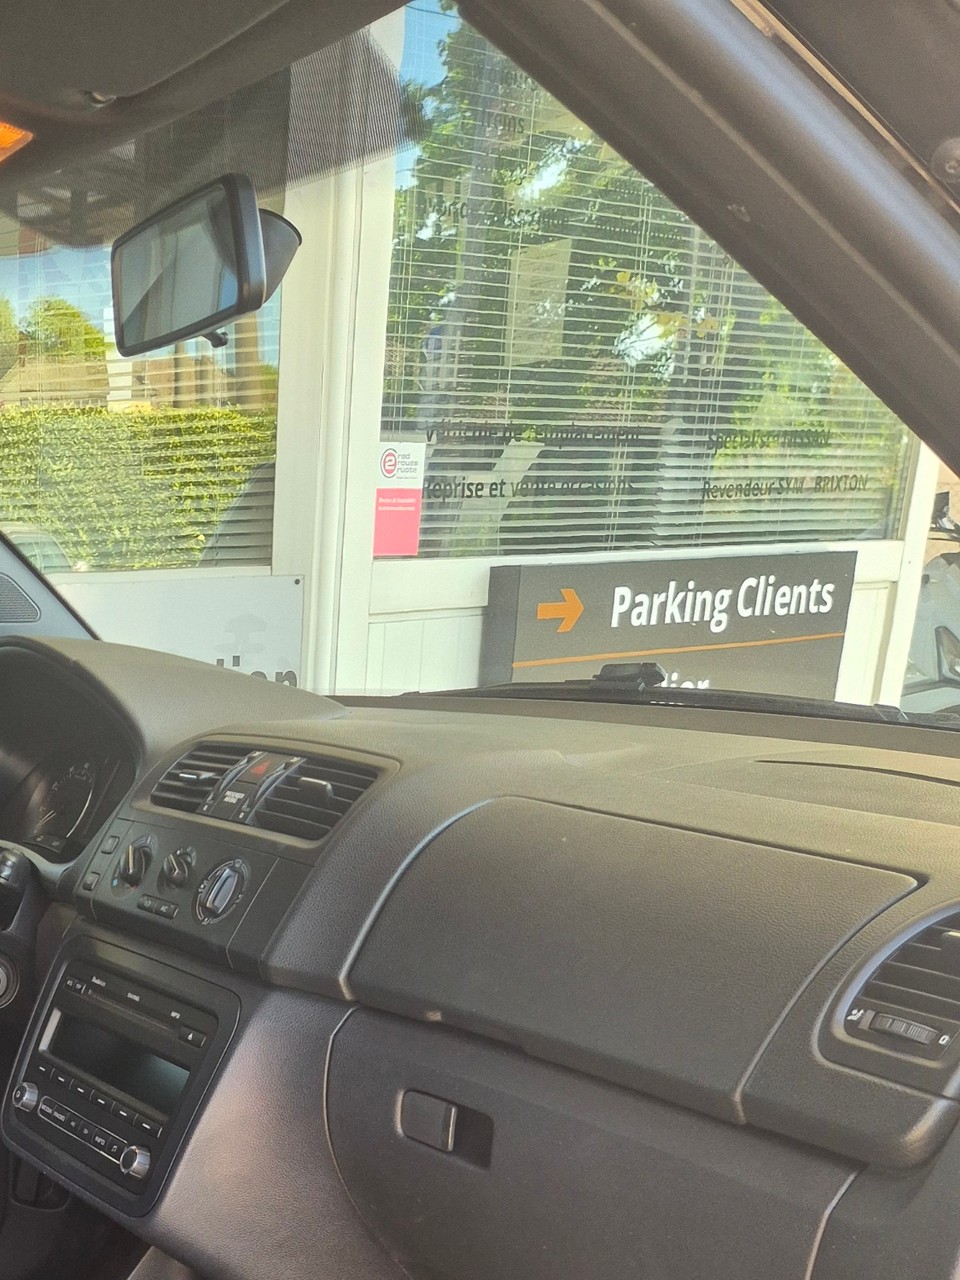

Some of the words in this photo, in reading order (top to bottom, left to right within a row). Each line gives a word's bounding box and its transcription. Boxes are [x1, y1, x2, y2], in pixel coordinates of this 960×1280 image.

[489, 478, 506, 498] et
[703, 480, 775, 501] Revendeur
[814, 474, 868, 493] BRIXTON
[610, 580, 733, 633] Parking
[737, 575, 835, 618] Clients
